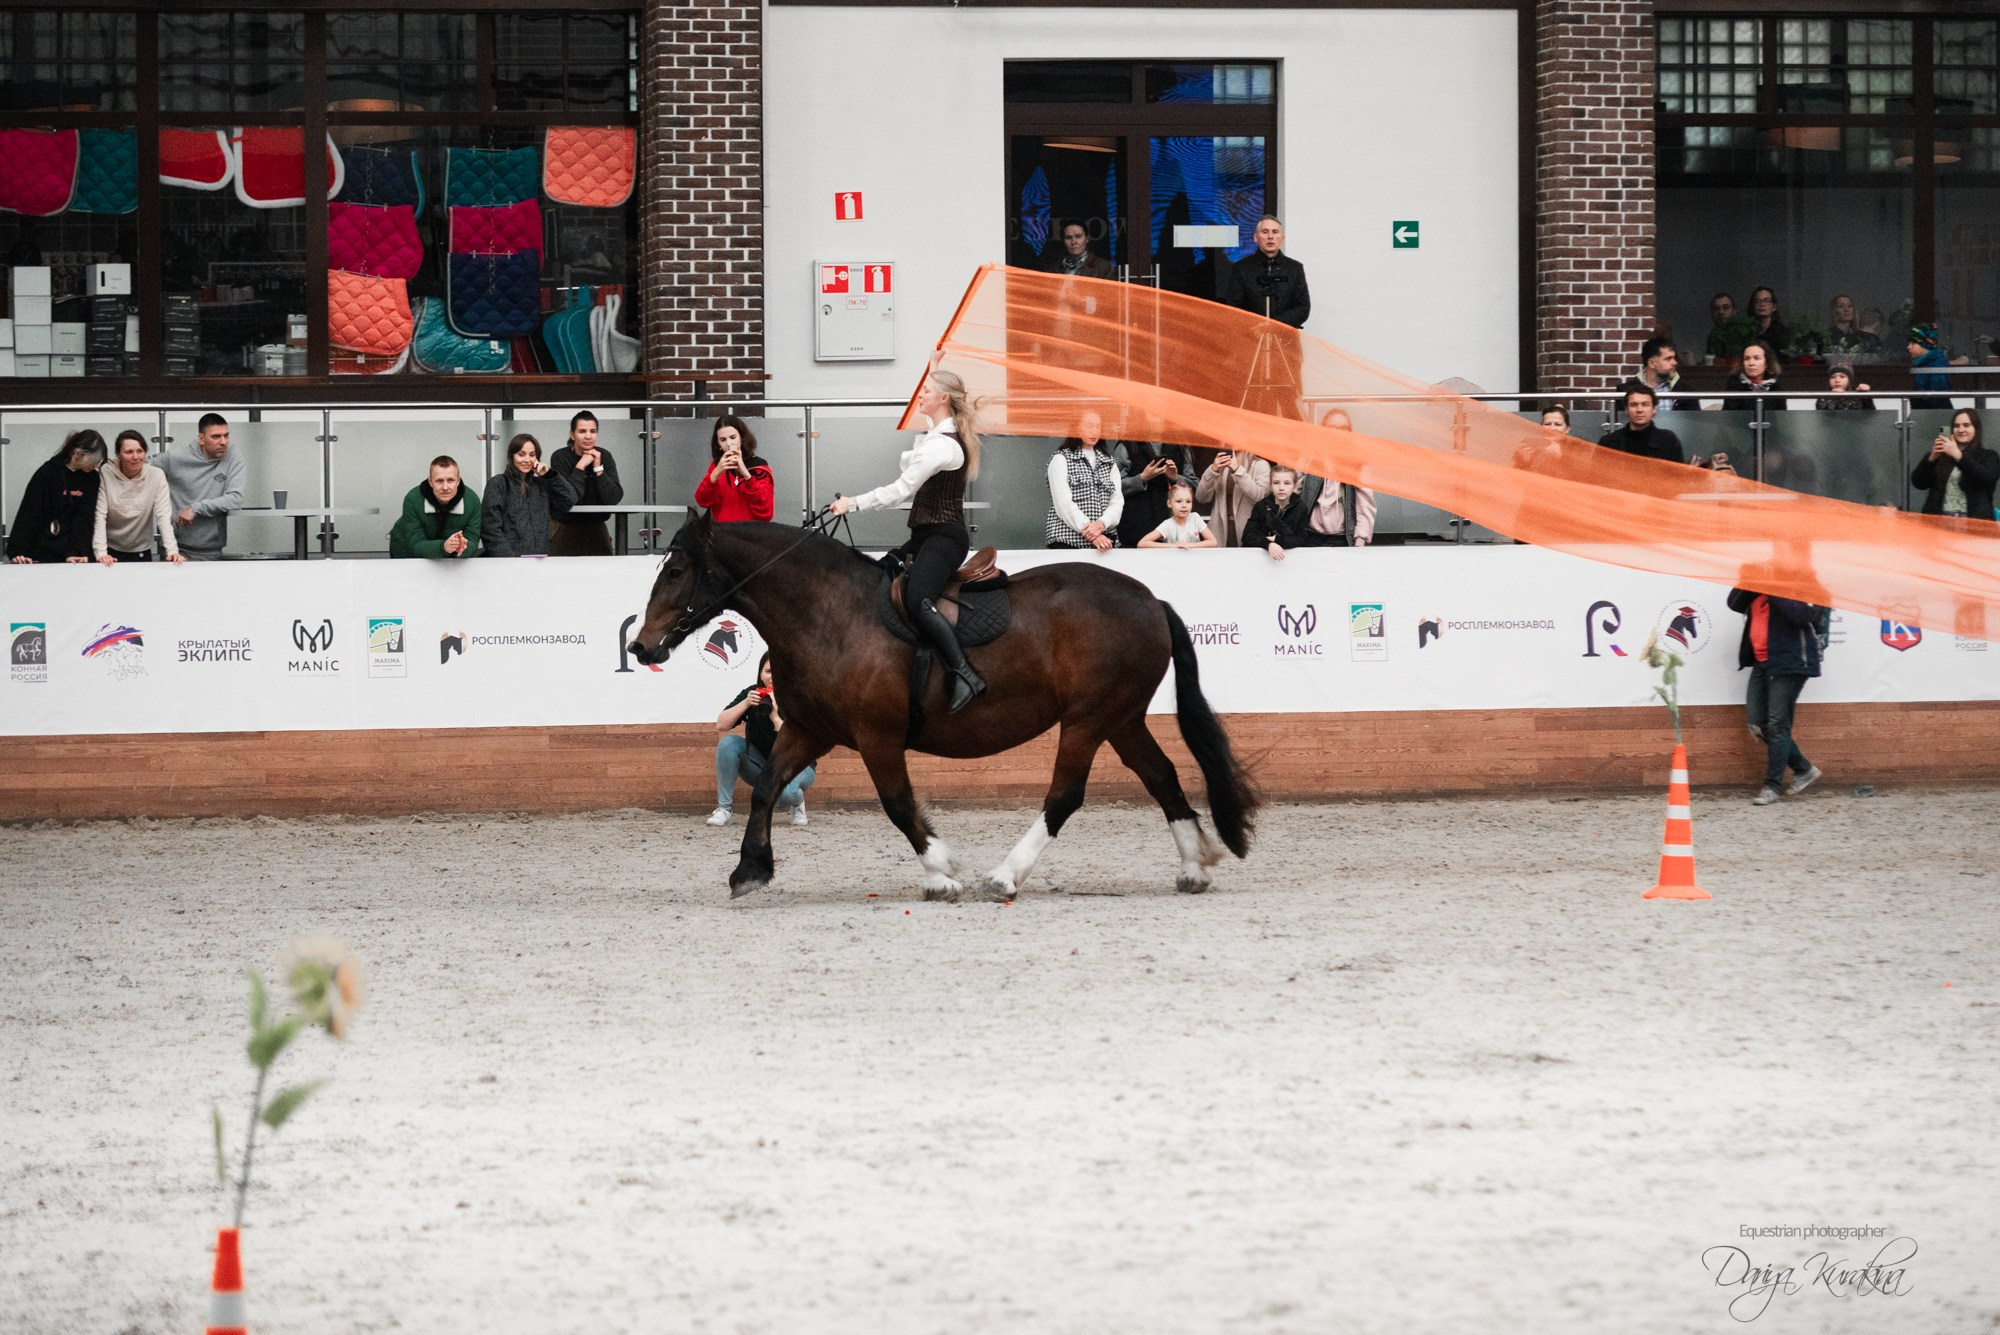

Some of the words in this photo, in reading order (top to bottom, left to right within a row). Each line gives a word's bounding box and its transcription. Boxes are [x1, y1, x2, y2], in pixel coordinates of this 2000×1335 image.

[1448, 619, 1556, 630] РОСПЛЕМКОНЗАВОД
[178, 637, 250, 649] КРЫЛАТЫЙ
[471, 634, 586, 645] РОСПЛЕМКОНЗАВОД
[178, 649, 252, 662] ЭКЛИПС
[11, 665, 48, 673] КОННАЯ
[11, 673, 48, 681] РОССИЯ
